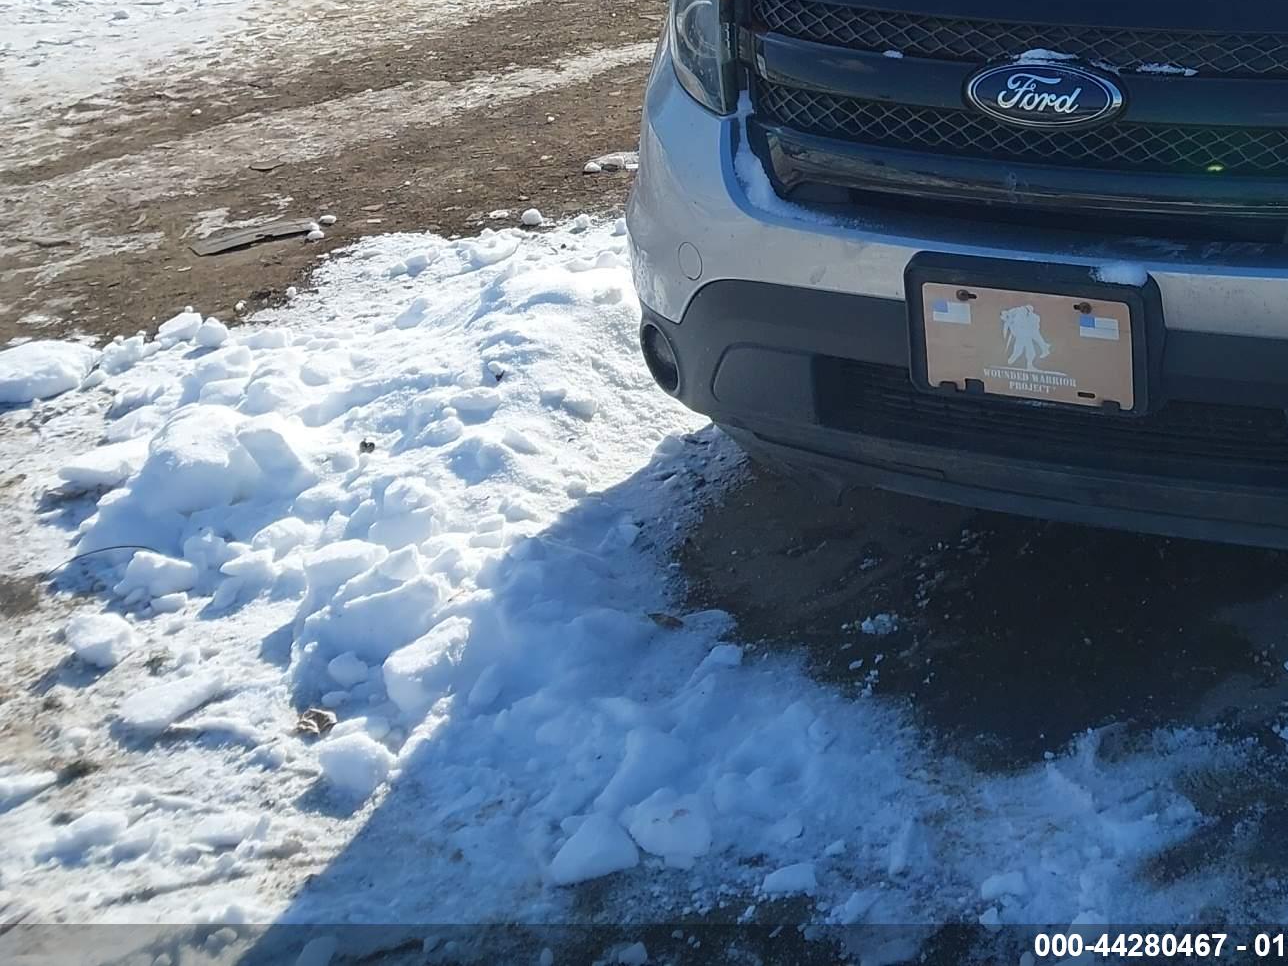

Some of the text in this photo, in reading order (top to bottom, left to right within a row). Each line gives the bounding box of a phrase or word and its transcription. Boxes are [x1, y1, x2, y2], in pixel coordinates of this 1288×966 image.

[996, 72, 1083, 115] Ford
[983, 368, 1077, 387] WOUNDED WARRIOR
[1008, 380, 1051, 394] PROJECT
